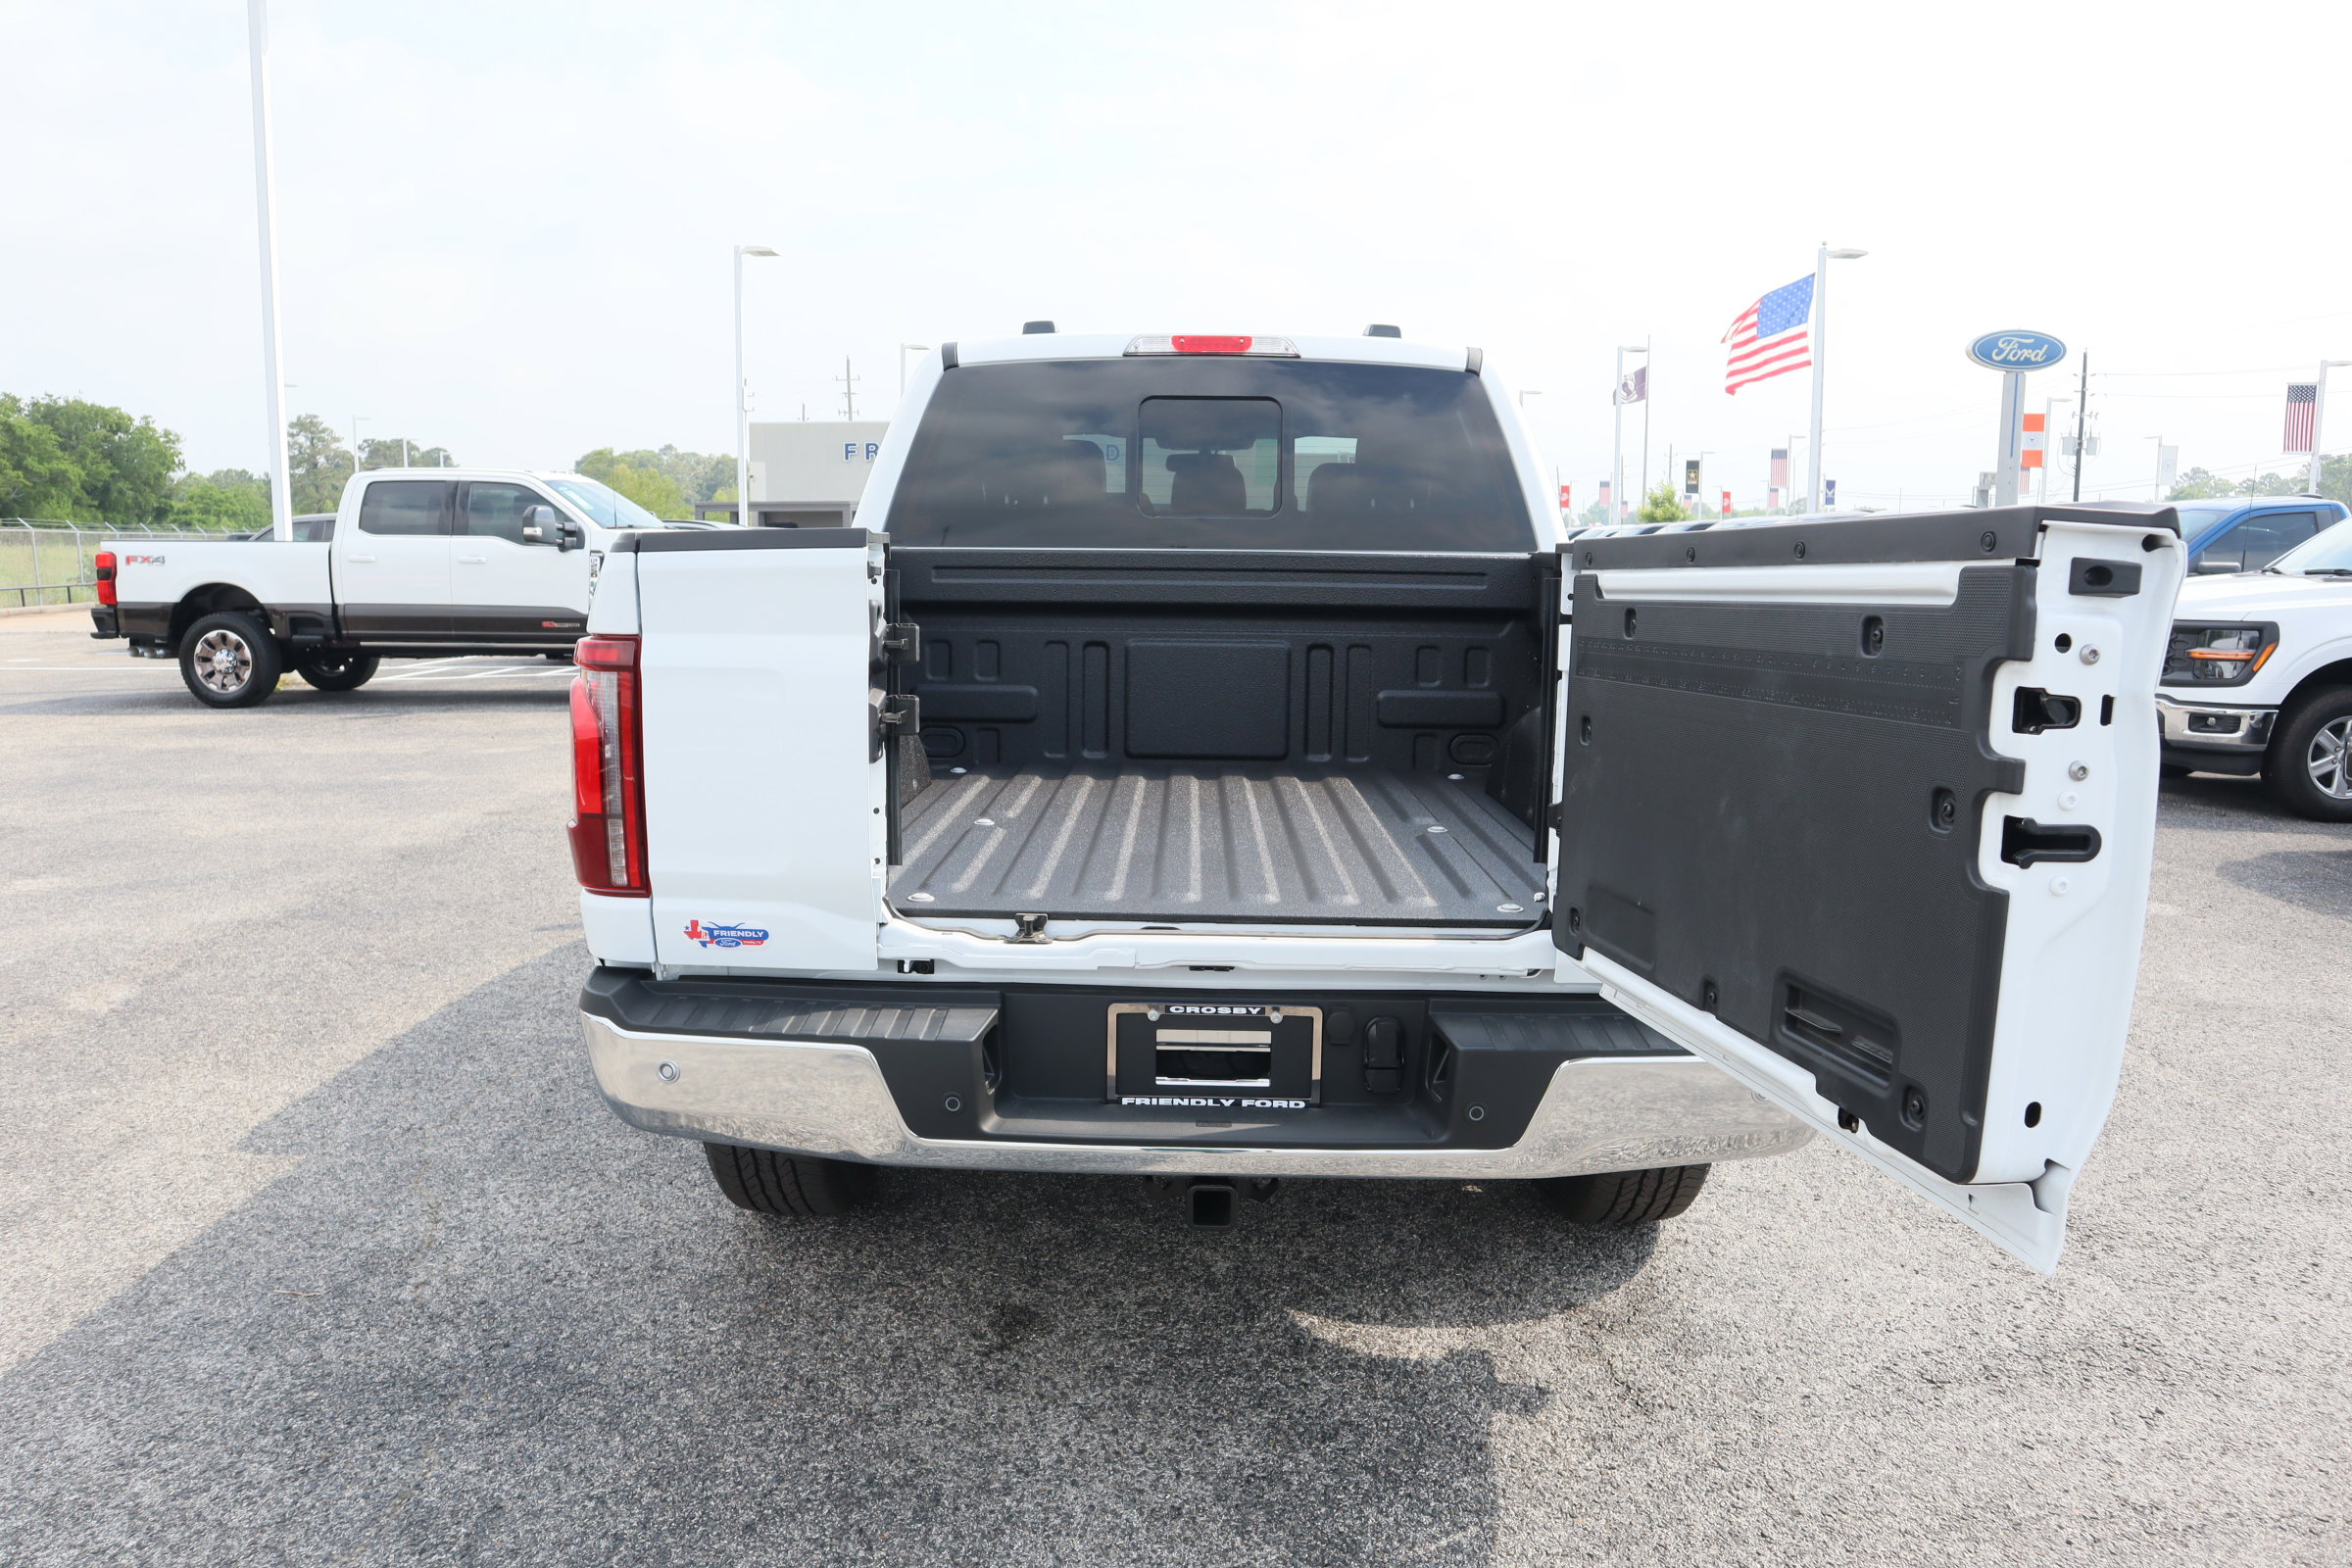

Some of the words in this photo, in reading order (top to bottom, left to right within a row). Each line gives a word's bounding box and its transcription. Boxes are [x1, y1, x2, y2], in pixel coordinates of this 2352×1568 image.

[1991, 336, 2049, 362] Ford
[125, 555, 166, 565] FX4
[713, 929, 764, 938] FRIENDLY
[1169, 1005, 1262, 1015] CROSBY
[1121, 1097, 1234, 1107] FRIENDLY
[1241, 1099, 1306, 1109] FORD
